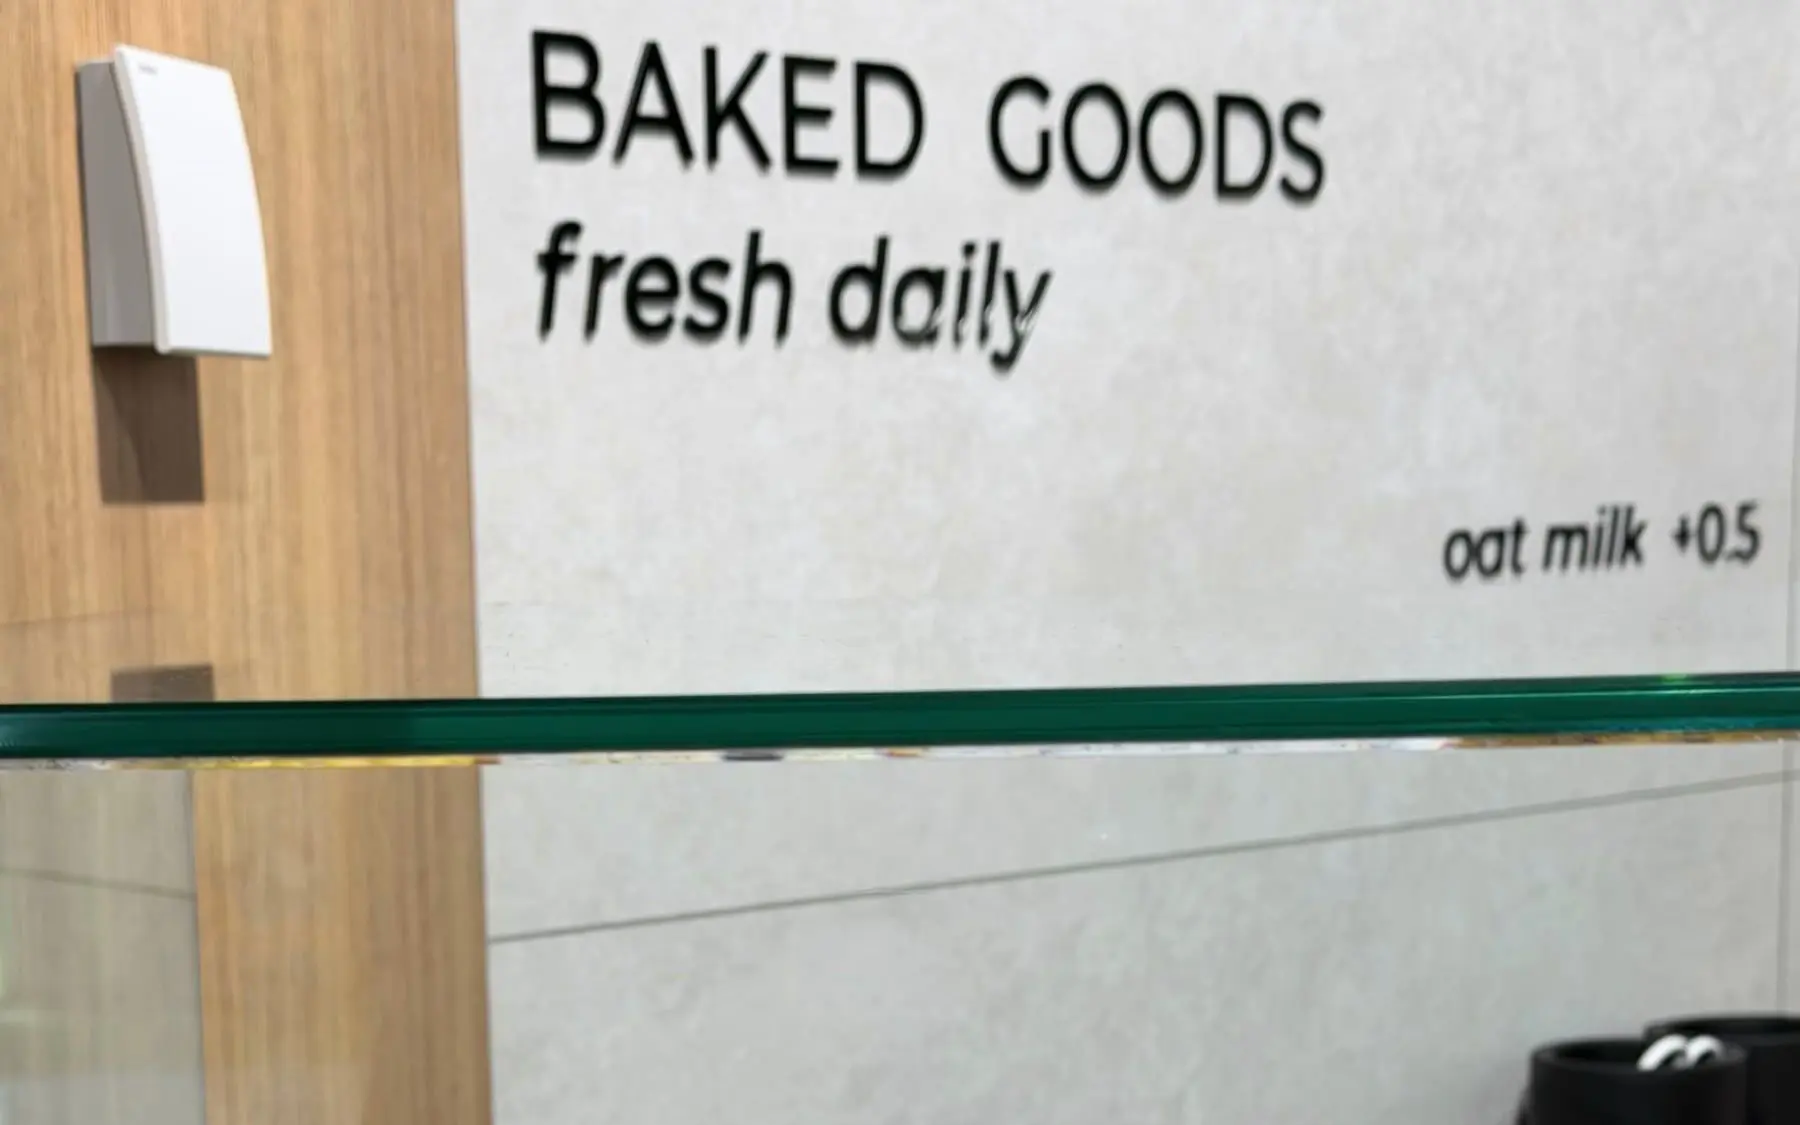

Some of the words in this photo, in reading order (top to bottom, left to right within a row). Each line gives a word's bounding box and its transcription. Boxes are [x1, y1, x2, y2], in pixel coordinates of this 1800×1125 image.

[531, 30, 924, 180] BAKED
[988, 75, 1324, 204] GOODS
[537, 220, 793, 343] fresh
[829, 235, 1052, 374] daily
[1442, 516, 1528, 583] oat
[1541, 503, 1648, 572] milk
